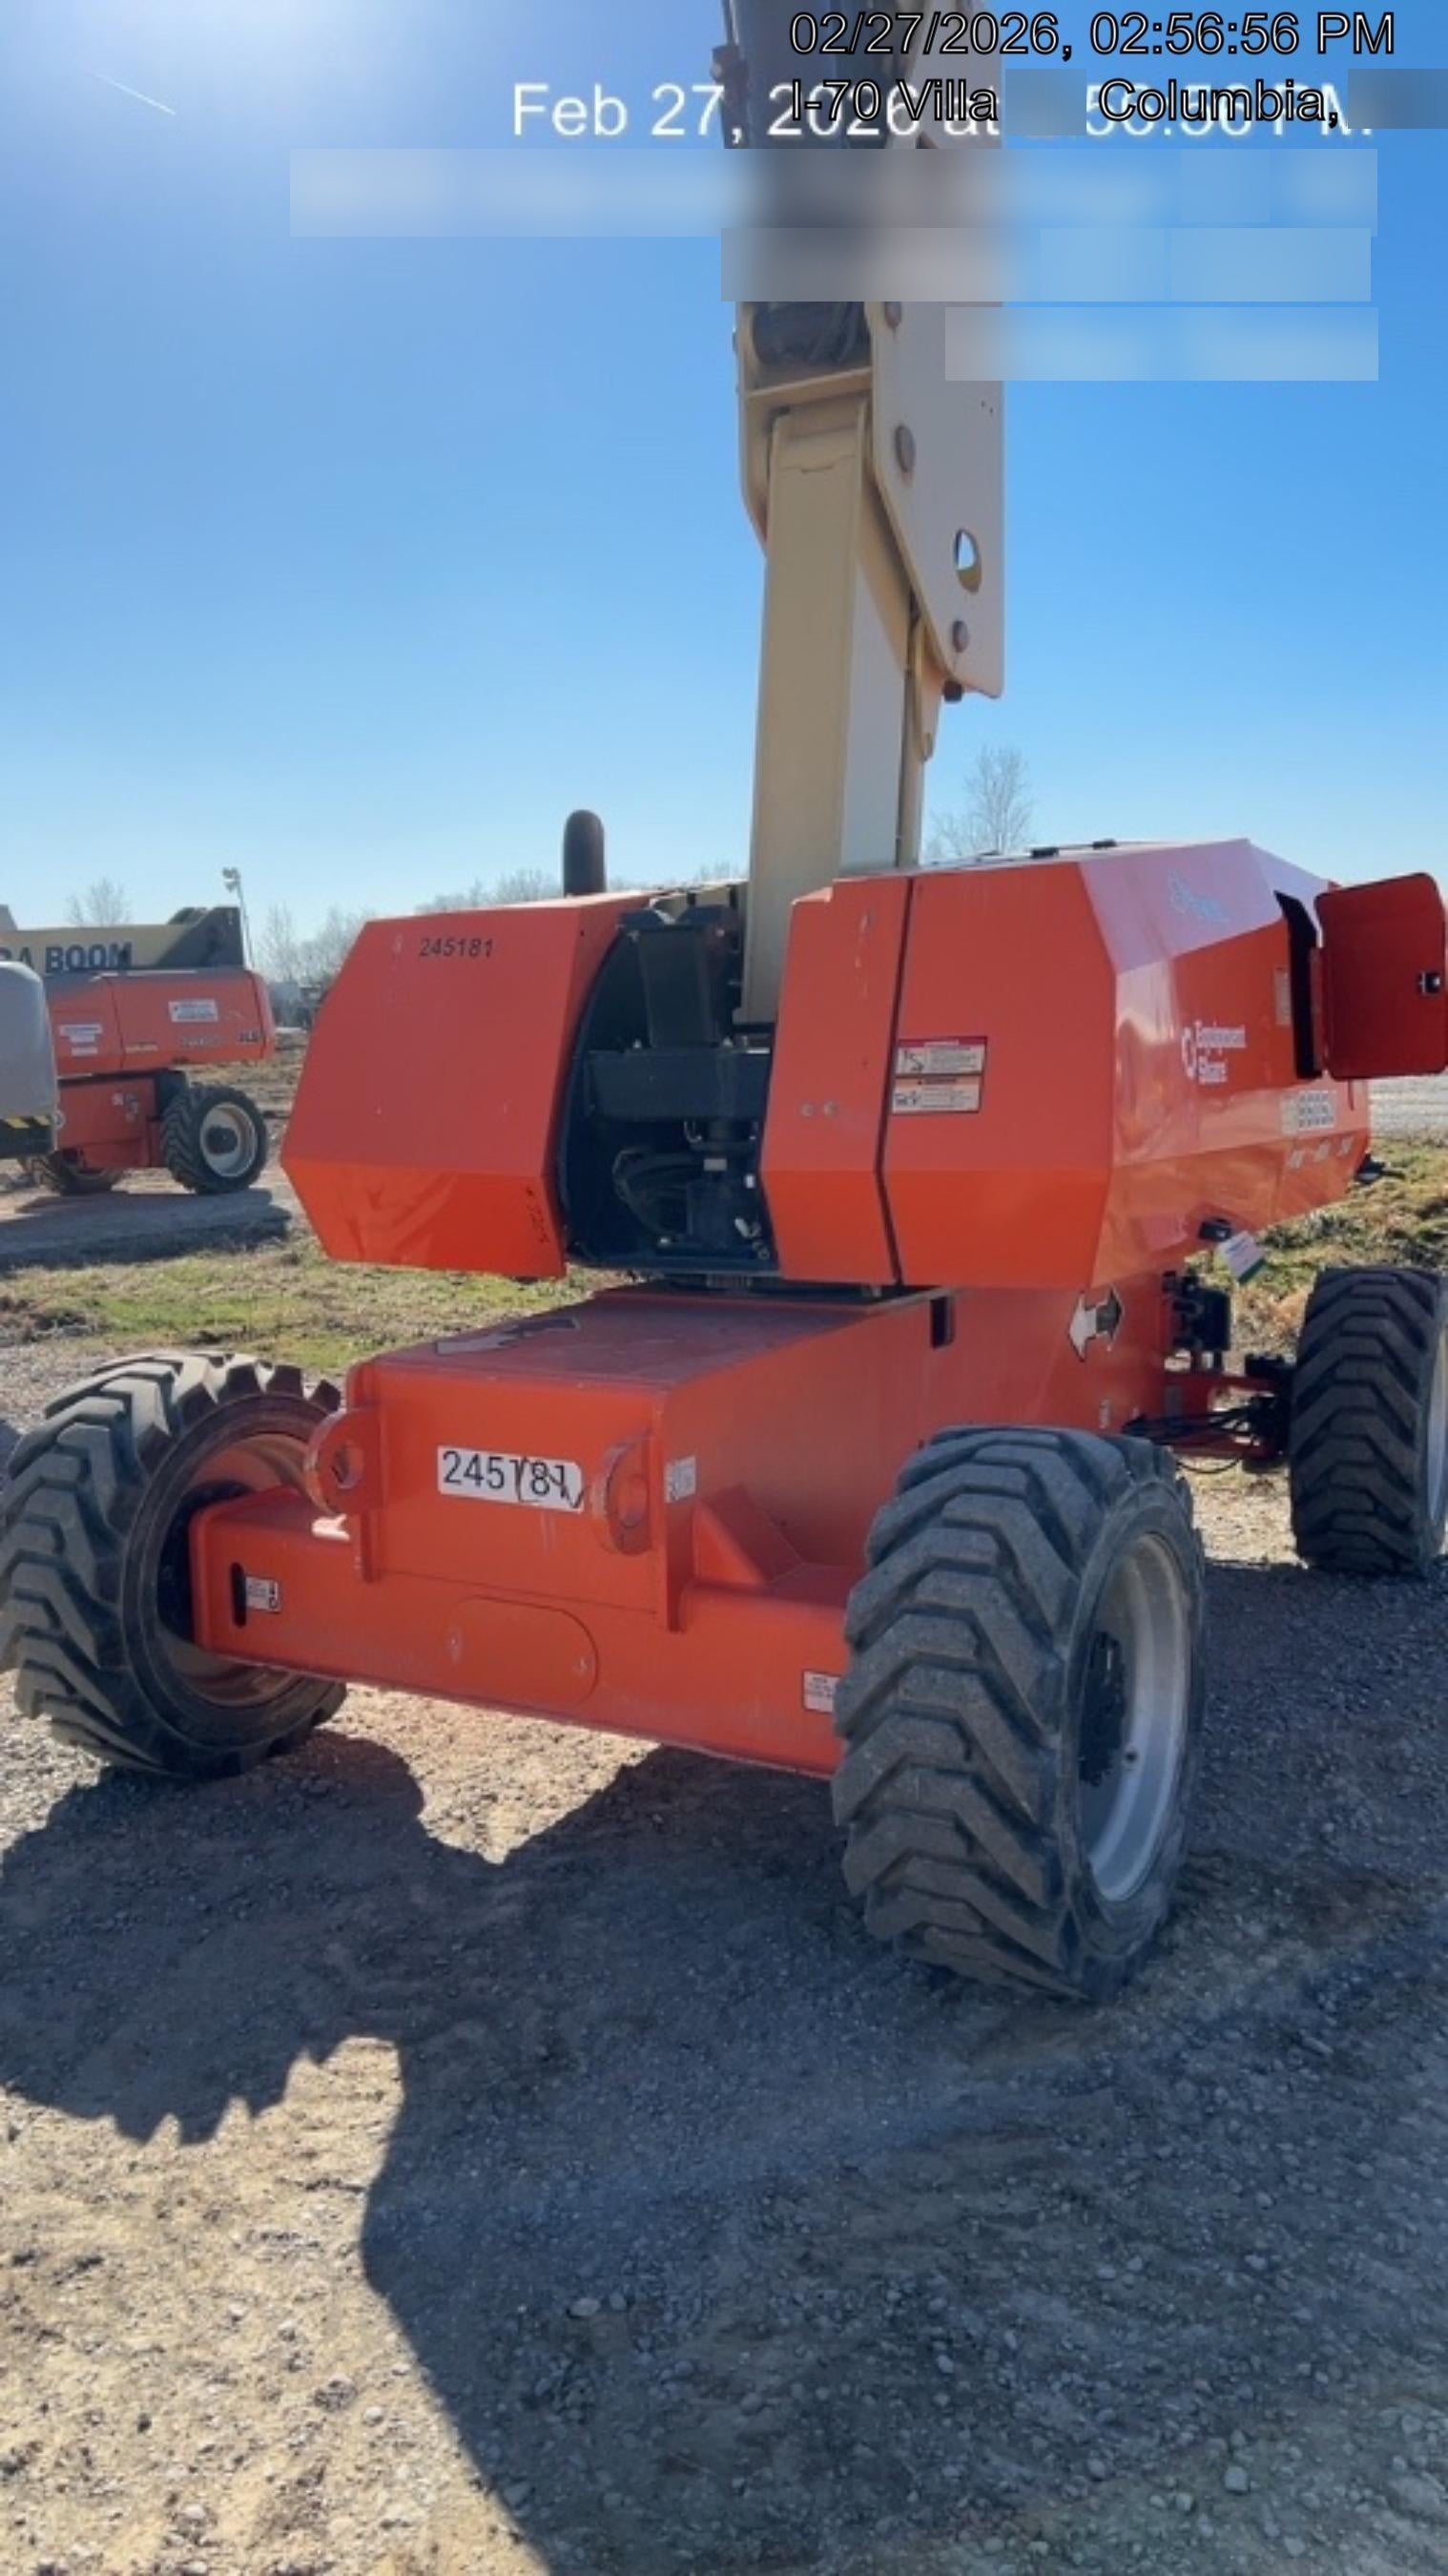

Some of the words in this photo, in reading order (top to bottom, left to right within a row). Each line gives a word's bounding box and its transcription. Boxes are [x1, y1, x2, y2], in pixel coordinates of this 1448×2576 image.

[45, 942, 133, 973] BOOM
[419, 938, 494, 957] 245181
[443, 1450, 567, 1499] 245181
